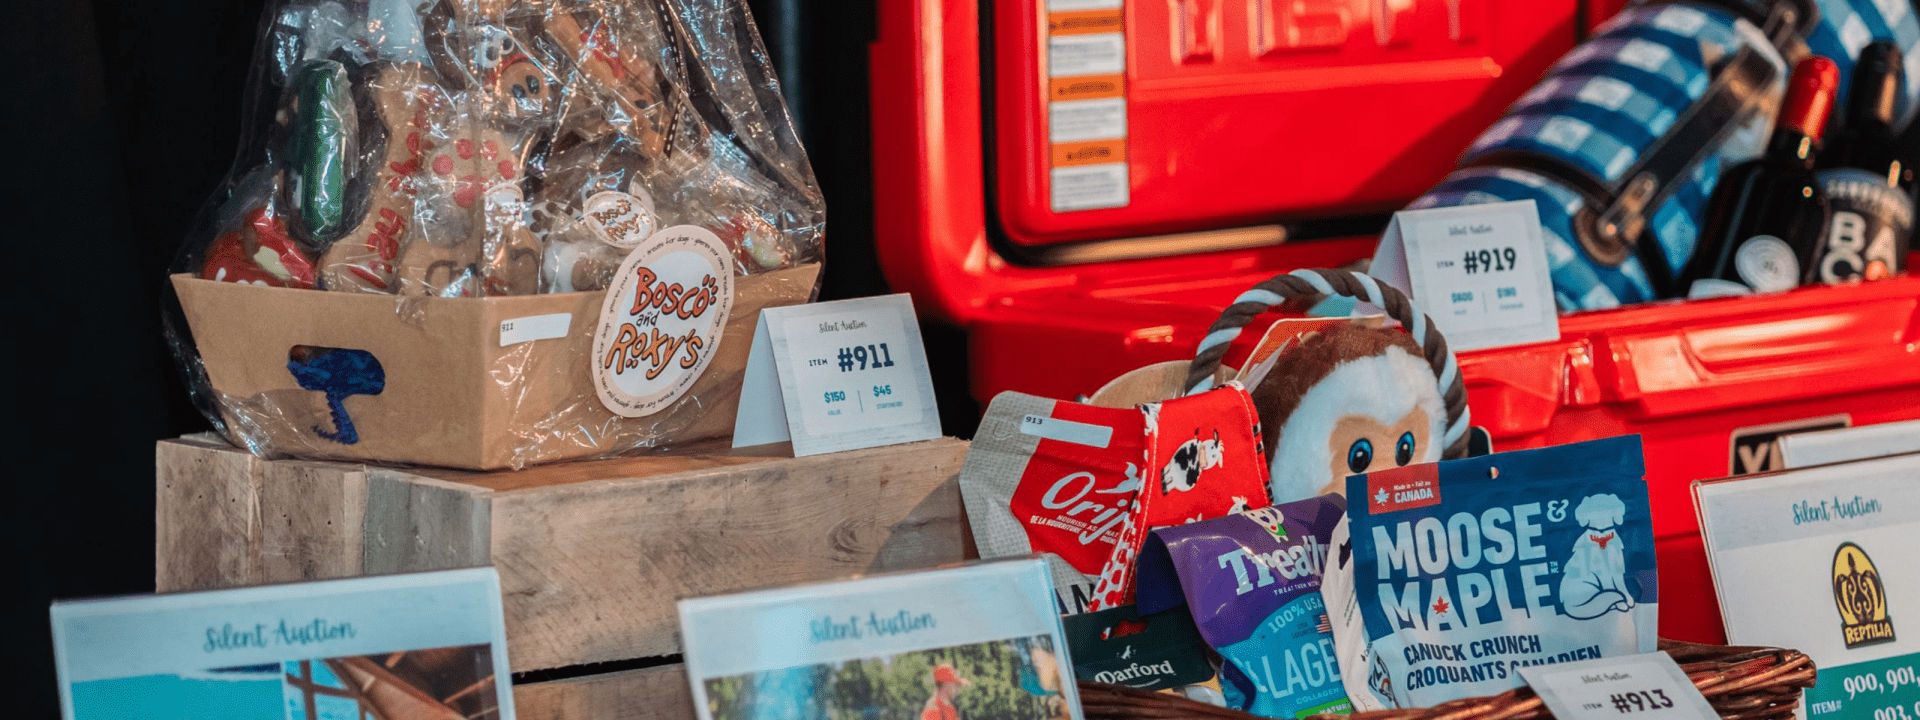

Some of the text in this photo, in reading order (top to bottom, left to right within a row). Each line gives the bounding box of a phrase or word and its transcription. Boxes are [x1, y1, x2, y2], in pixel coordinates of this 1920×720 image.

[1464, 246, 1516, 274] #919
[502, 322, 514, 332] 911
[636, 311, 660, 327] and
[819, 320, 867, 333] Silent Auction
[604, 322, 703, 380] Roxy's
[809, 343, 894, 372] ITEM #911
[824, 391, 846, 404] $150
[873, 384, 892, 397] $45
[1026, 416, 1042, 424] 913
[1395, 488, 1433, 503] CANADA
[1792, 495, 1882, 525] Silent Auction
[1056, 515, 1088, 528] NOURISH
[1087, 524, 1098, 532] AS
[1371, 499, 1569, 580] MOOSE &
[1274, 585, 1294, 595] TREAT
[1377, 562, 1557, 631] MAPLE
[809, 609, 937, 643] Silent Auction
[1268, 604, 1305, 633] 100%
[1303, 597, 1324, 611] USA
[203, 618, 356, 653] Silent Auction
[1845, 622, 1893, 644] REPTILIA
[1404, 635, 1542, 665] CANUCK CRUNCH
[1095, 660, 1175, 684] Darford
[1406, 661, 1507, 691] CROQUANTS
[1843, 673, 1884, 701] 900,
[1610, 689, 1674, 713] #913
[1812, 699, 1842, 715] ITEM#
